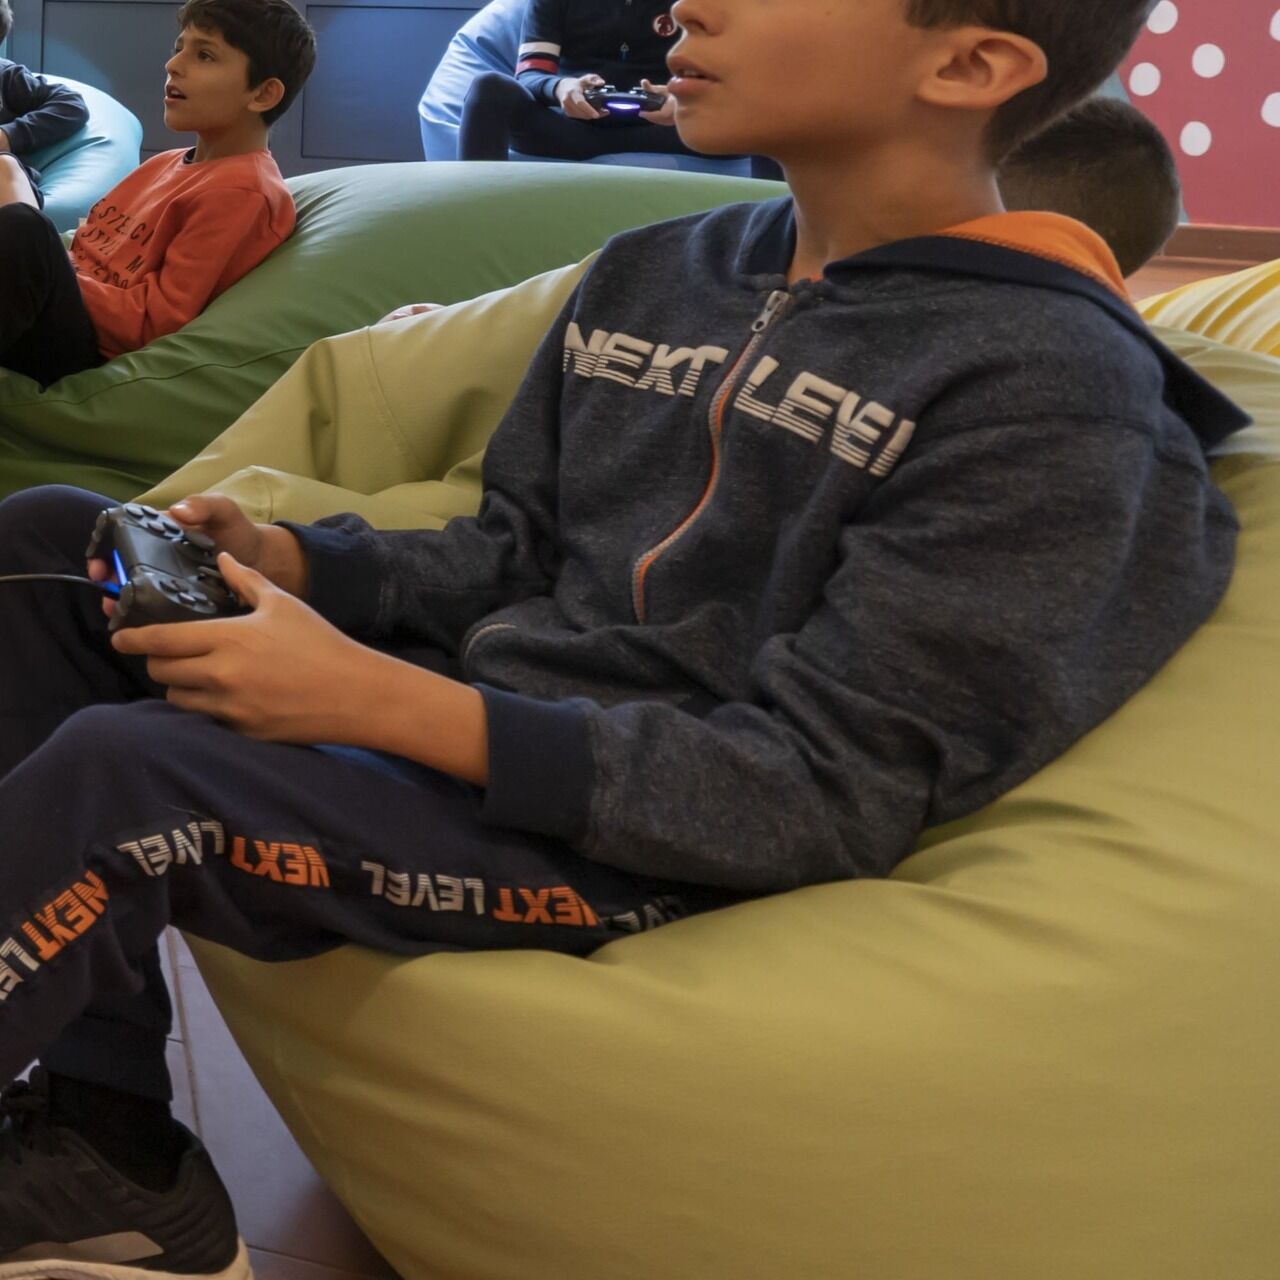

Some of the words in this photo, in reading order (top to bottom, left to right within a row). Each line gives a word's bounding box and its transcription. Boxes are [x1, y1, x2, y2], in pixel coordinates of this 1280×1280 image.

[563, 321, 729, 398] NEXT
[20, 870, 110, 961] NEXT
[361, 860, 486, 915] LEVEL
